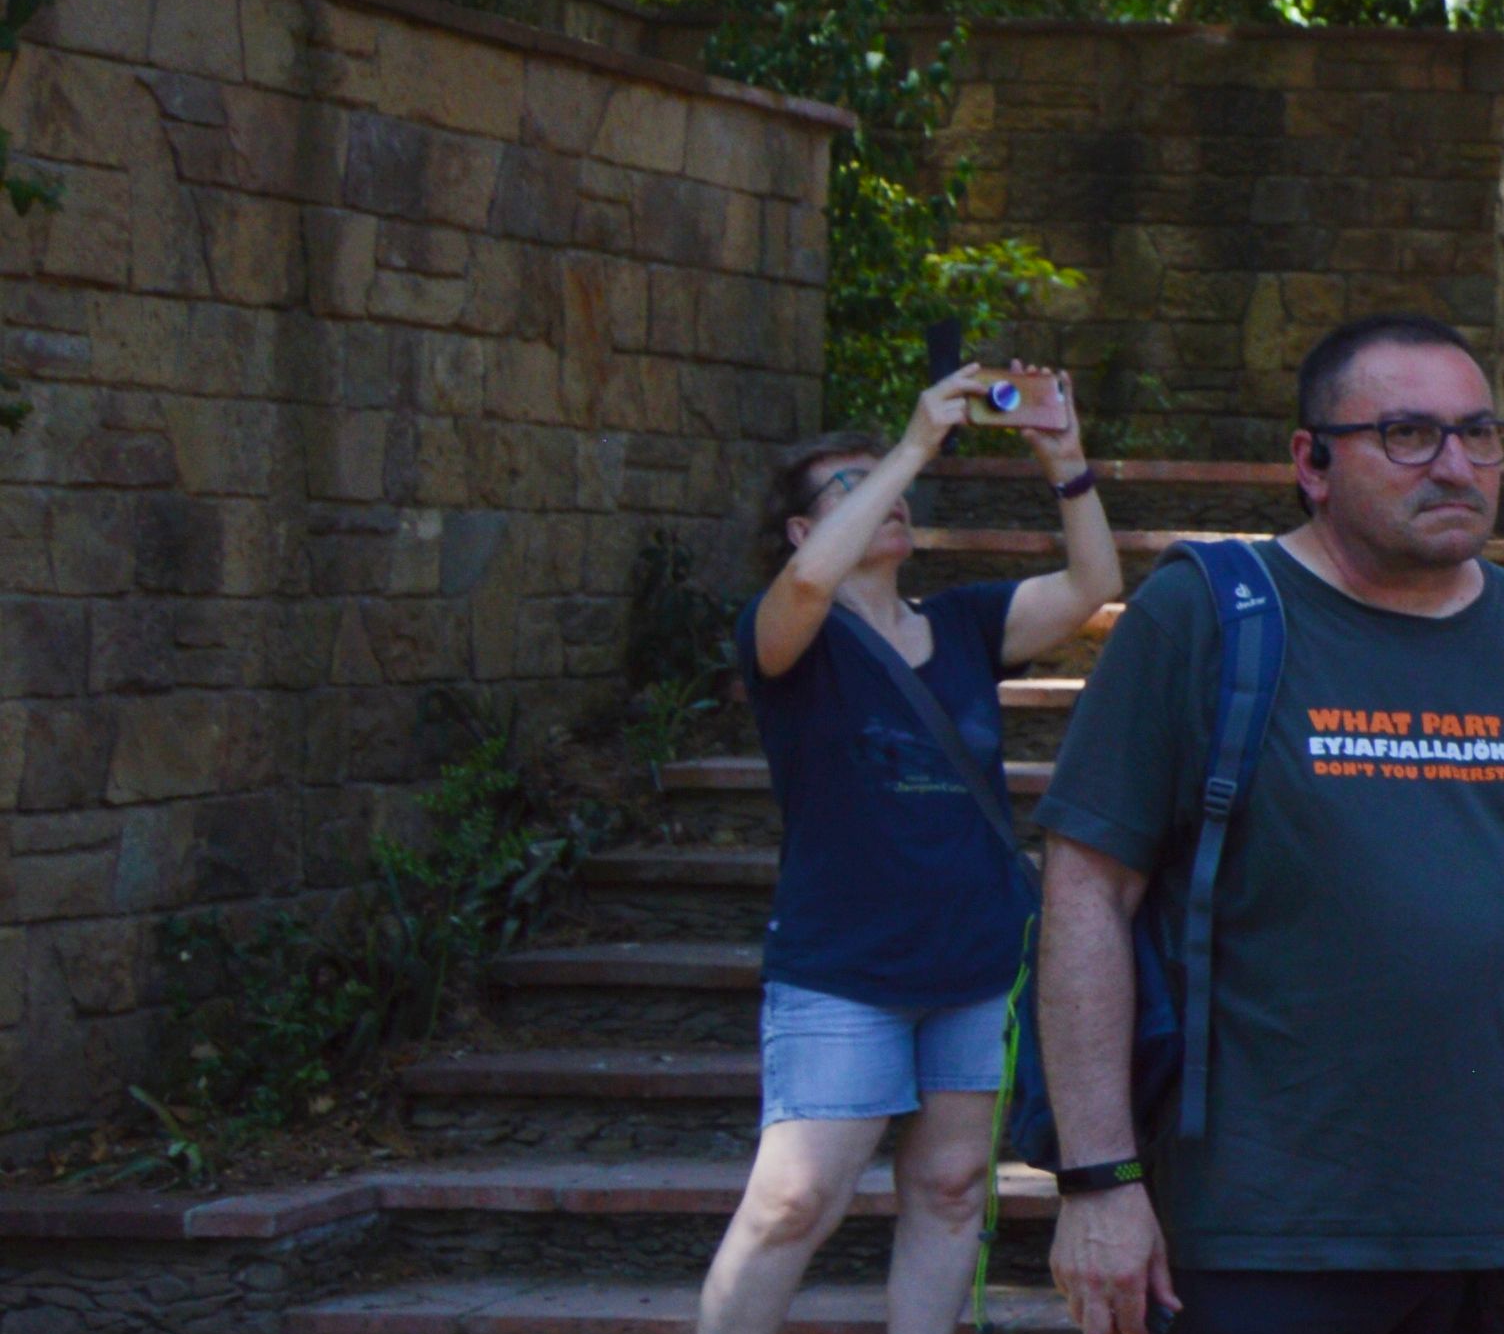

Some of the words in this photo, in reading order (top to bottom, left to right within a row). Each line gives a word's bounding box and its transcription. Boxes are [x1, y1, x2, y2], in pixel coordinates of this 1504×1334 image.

[1308, 709, 1411, 735] WHAT
[1421, 712, 1502, 737] PART
[1313, 762, 1375, 778] DON'T
[1380, 764, 1418, 779] YOU
